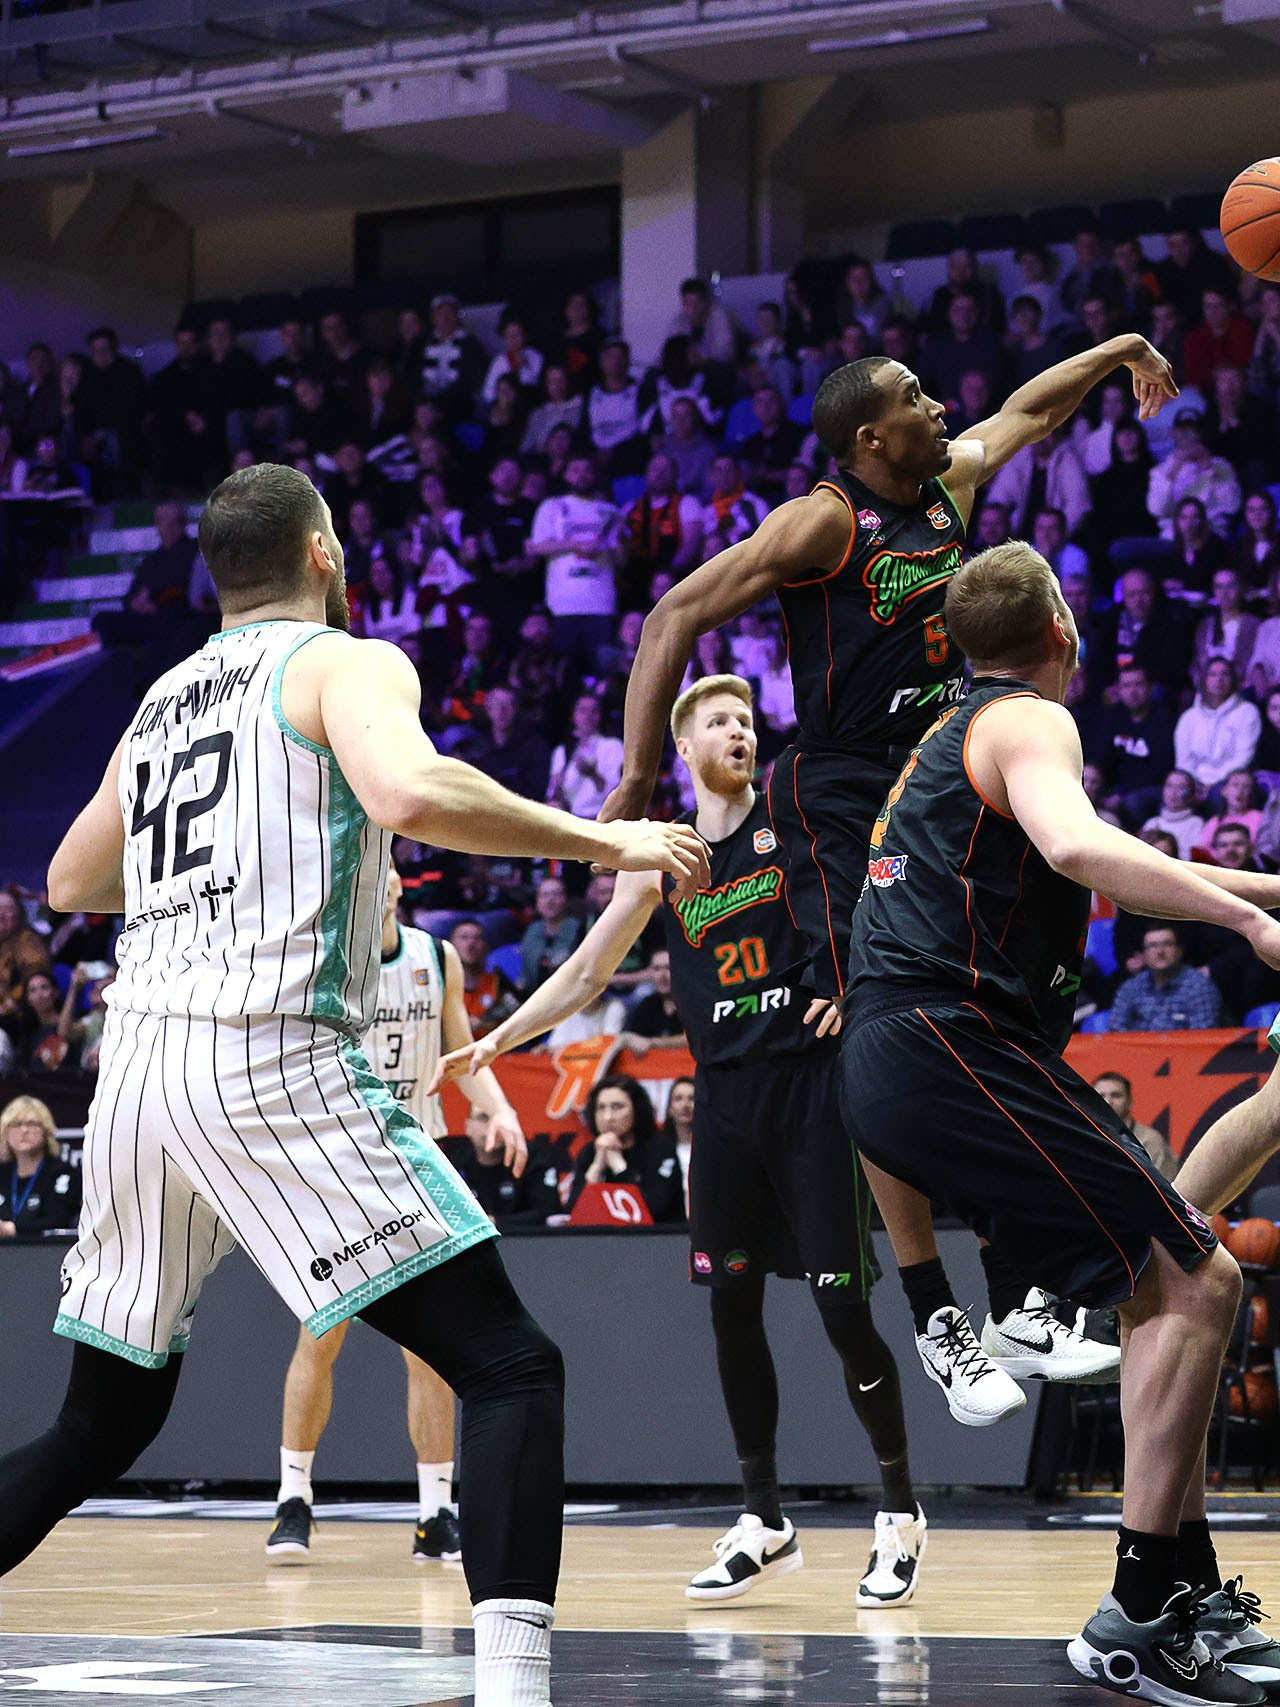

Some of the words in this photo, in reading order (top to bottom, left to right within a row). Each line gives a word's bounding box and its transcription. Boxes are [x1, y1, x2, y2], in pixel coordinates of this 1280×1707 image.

[923, 614, 950, 665] 5
[131, 731, 233, 884] 42
[122, 903, 191, 933] ETOUR
[714, 937, 770, 987] 20
[712, 986, 791, 1023] PARI
[384, 1033, 403, 1069] 3
[332, 1209, 426, 1266] МЕГАФОН
